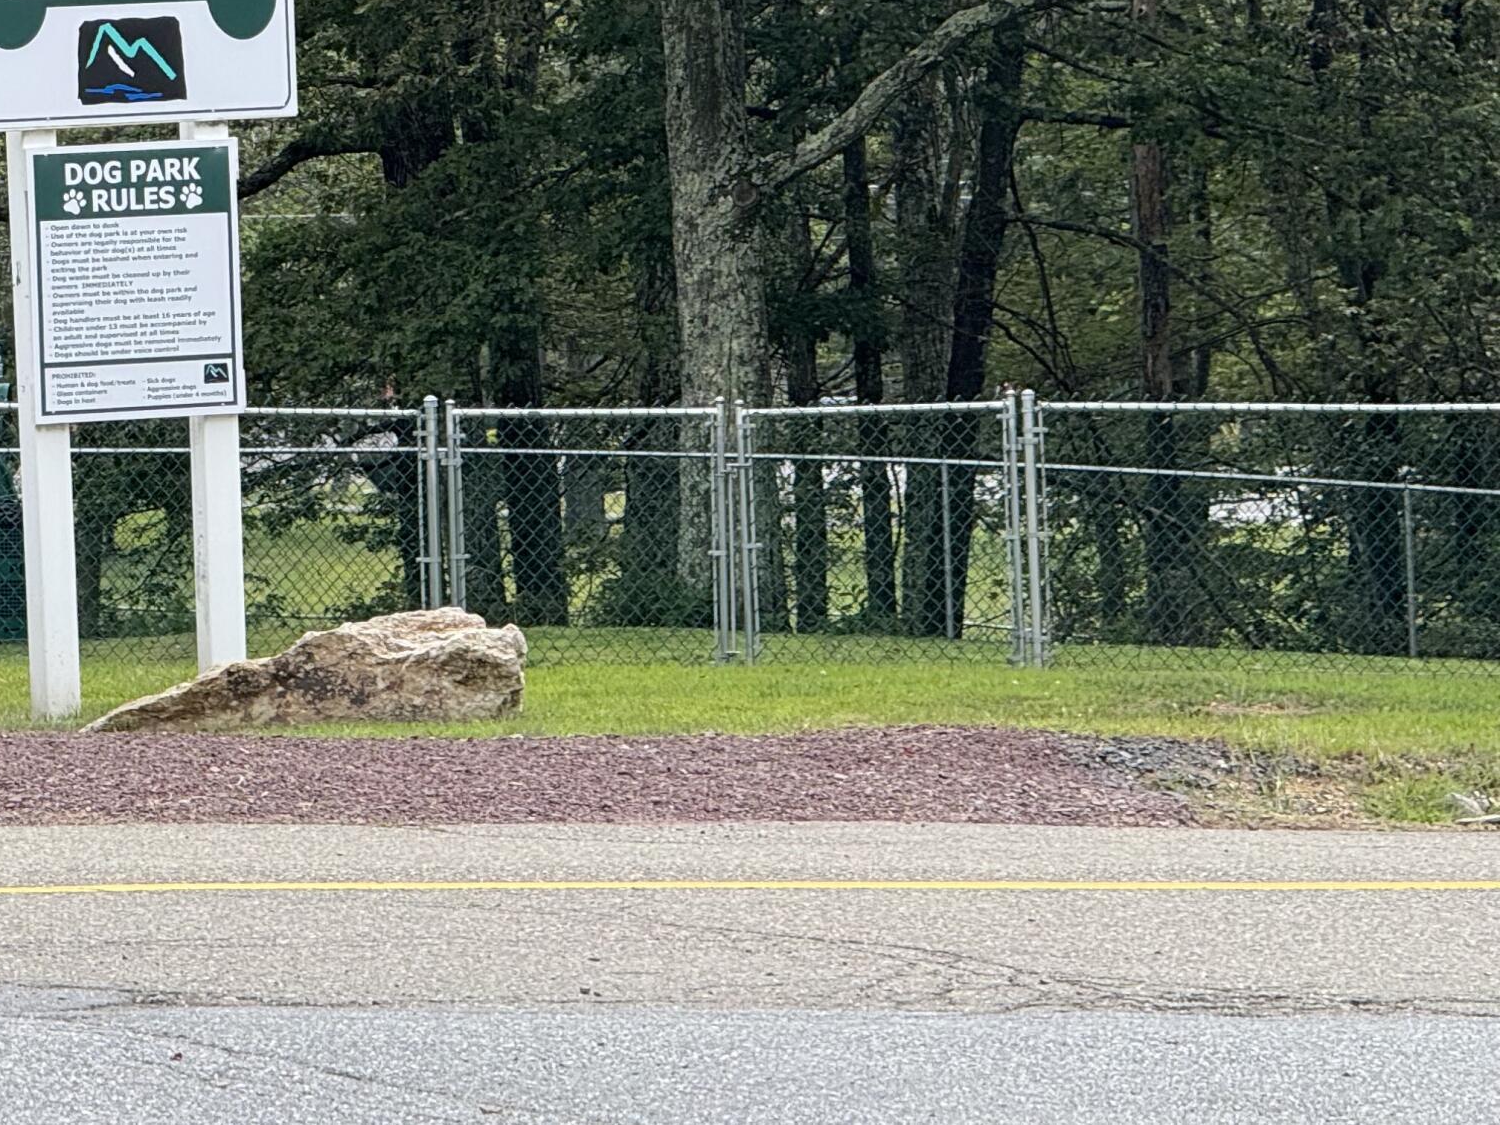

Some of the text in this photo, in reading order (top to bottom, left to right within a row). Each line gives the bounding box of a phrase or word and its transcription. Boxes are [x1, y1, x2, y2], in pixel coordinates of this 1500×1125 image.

[65, 157, 200, 185] DOG PARK
[92, 186, 175, 212] RULES
[49, 224, 69, 232] Open
[88, 231, 102, 239] dog
[103, 230, 120, 238] park
[50, 240, 78, 248] Owners
[93, 238, 117, 247] legally
[49, 248, 82, 256] behavior
[51, 257, 70, 266] Dogs
[101, 254, 130, 262] leashed
[152, 252, 183, 261] entering
[50, 266, 76, 274] exiting
[90, 264, 107, 272] park
[121, 270, 150, 278] cleaned
[162, 269, 171, 277] by
[51, 291, 80, 299] Owners
[150, 287, 164, 295] dog
[165, 286, 182, 294] park
[113, 297, 127, 305] dog
[167, 294, 191, 302] readily
[51, 308, 85, 316] available
[52, 317, 68, 325] Dog
[69, 315, 101, 323] handlers
[102, 314, 121, 322] must
[171, 311, 192, 319] years
[52, 324, 84, 332] Children
[197, 318, 207, 326] by
[98, 330, 138, 339] supervised
[53, 341, 94, 350] Aggressive
[94, 340, 112, 348] dogs
[143, 336, 175, 345] removed
[177, 334, 222, 344] immediately
[53, 350, 73, 358] Dogs
[73, 349, 98, 357] should
[86, 380, 98, 388] dog
[161, 376, 175, 384] dogs
[146, 383, 196, 393] Aggressive dogs
[146, 392, 172, 400] Puppies
